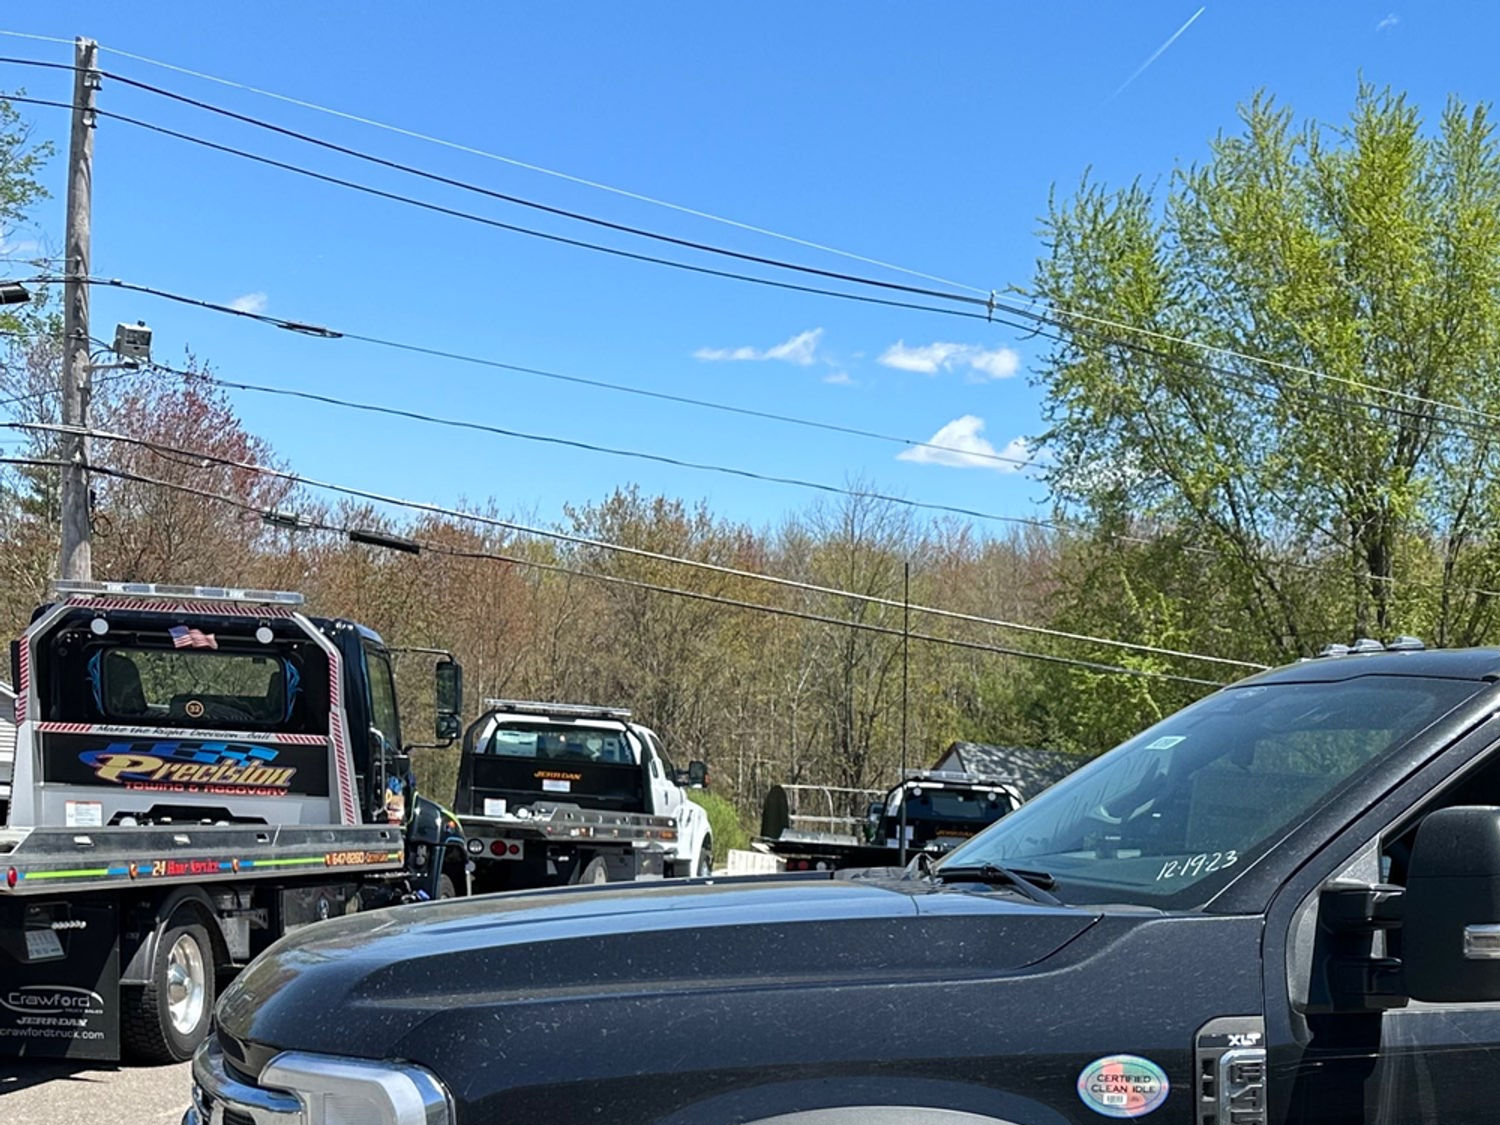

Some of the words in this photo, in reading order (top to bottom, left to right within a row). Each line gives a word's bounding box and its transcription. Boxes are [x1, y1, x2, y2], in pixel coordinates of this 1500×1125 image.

[130, 726, 151, 735] the
[96, 754, 297, 787] Precision
[152, 861, 166, 876] 24
[8, 992, 90, 1008] Crawford
[0, 1027, 105, 1040] crawfordtruck.com
[1227, 1032, 1262, 1047] XLT
[1096, 1073, 1152, 1084] CERTIFIED
[1090, 1084, 1128, 1094] CLEAN
[1132, 1085, 1156, 1094] IDLE
